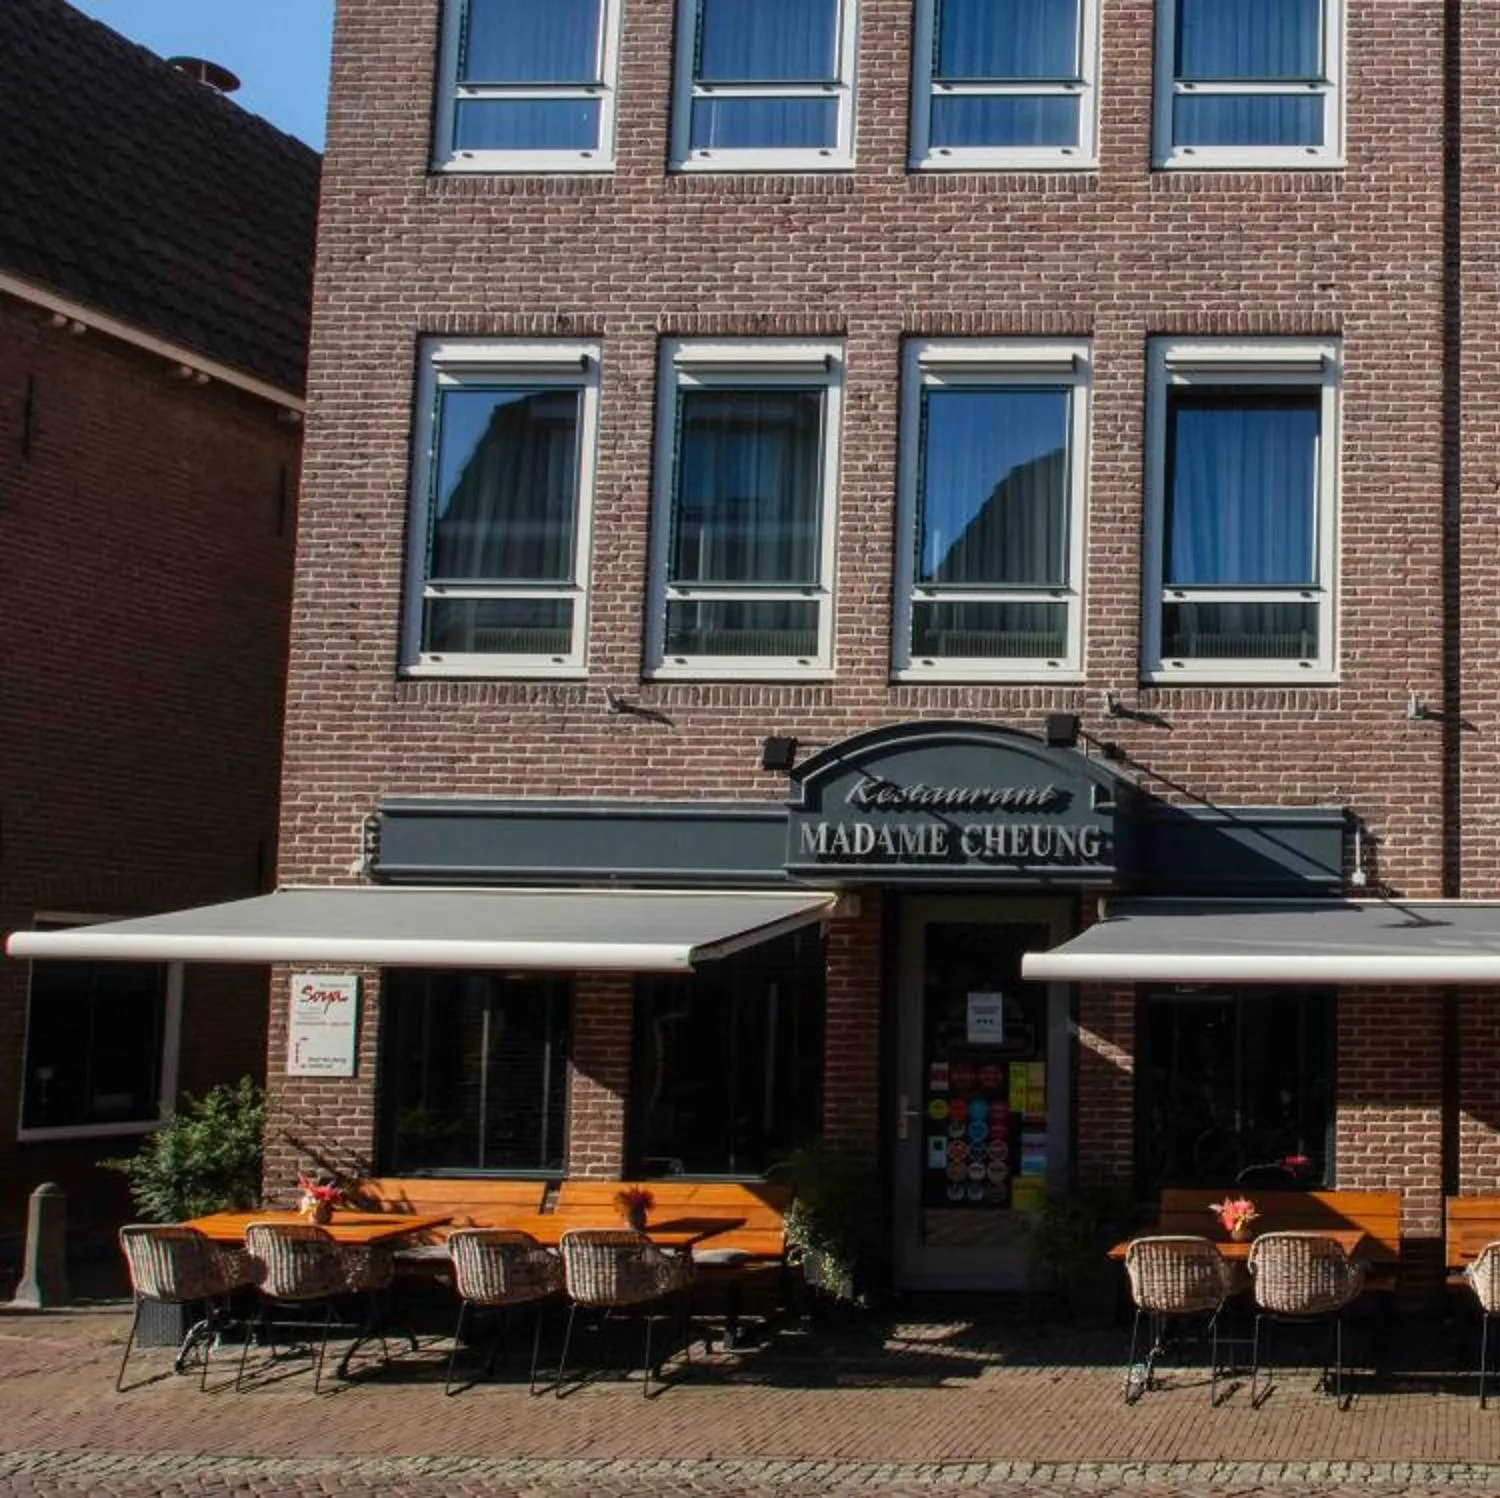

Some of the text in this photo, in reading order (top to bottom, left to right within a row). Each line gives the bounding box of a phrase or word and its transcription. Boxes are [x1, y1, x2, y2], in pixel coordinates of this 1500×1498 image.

[845, 774, 1056, 805] Restaurant
[799, 821, 1101, 859] MADAME CHEUNG
